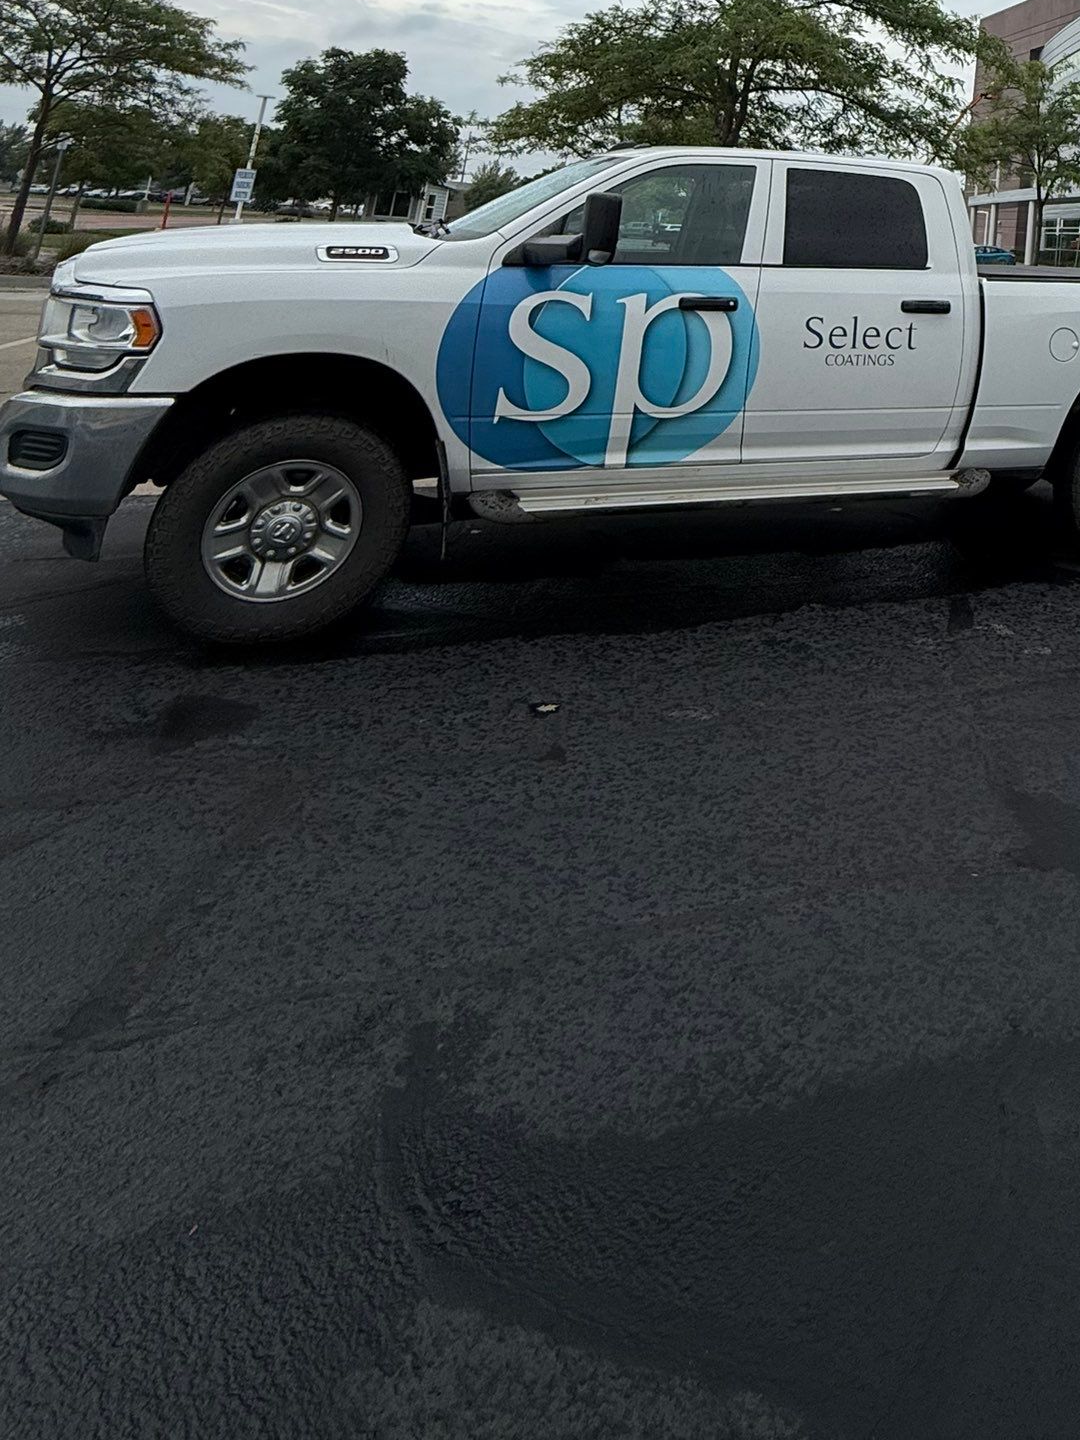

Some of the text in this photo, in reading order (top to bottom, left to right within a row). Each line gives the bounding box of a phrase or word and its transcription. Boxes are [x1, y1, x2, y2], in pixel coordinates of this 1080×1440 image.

[330, 247, 384, 255] 2500
[803, 316, 918, 350] Select
[825, 354, 895, 367] COATINGS
